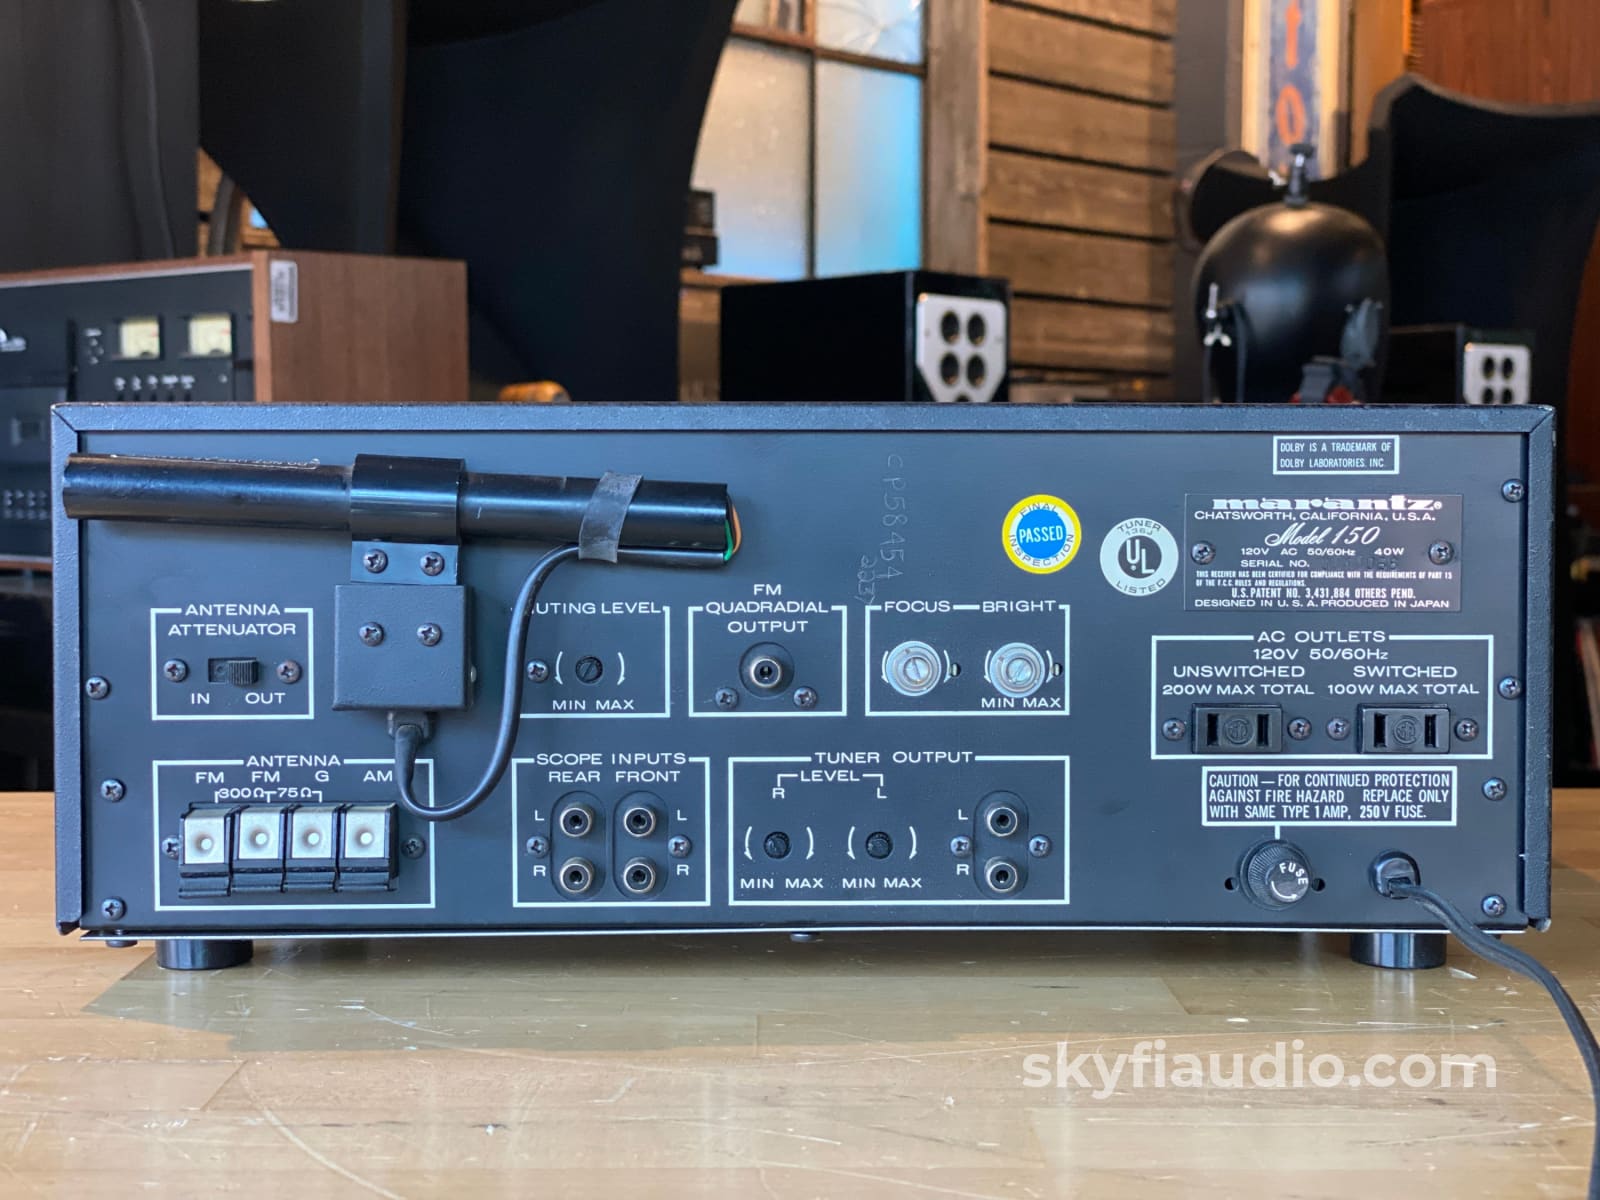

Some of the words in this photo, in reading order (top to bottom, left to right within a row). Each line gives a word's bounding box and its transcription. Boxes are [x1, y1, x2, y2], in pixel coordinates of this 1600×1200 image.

[1280, 442, 1305, 452] DOLBY
[1310, 442, 1318, 452] IS
[1321, 442, 1328, 452] A
[1331, 442, 1377, 452] TRADEMARK
[1381, 442, 1393, 452] OF
[1280, 458, 1305, 468] DOLBY
[1018, 502, 1060, 517] FINAL
[1194, 510, 1297, 521] CHATSWORTH,
[1299, 511, 1389, 521] CALIFORNIA,
[1117, 519, 1162, 533] TUNER
[1018, 524, 1064, 545] PASSED
[1264, 522, 1329, 546] Model
[1331, 525, 1381, 545] 150
[1008, 533, 1076, 567] INSPECTION
[1241, 547, 1270, 556] 120V
[1280, 547, 1298, 556] AC
[1307, 547, 1356, 556] 50/60Hz
[1374, 547, 1405, 556] 40W
[1125, 539, 1155, 574] UL
[1240, 559, 1284, 568] SERIAL
[1289, 559, 1310, 568] NO.
[1297, 570, 1308, 578] FOR
[1310, 571, 1345, 579] COMPLIANCE
[1363, 571, 1374, 579] THE
[1116, 577, 1166, 595] LISTED
[1205, 579, 1216, 587] THE
[1234, 579, 1252, 587] RULES
[1254, 579, 1266, 587] AND
[753, 584, 782, 596] FM
[1250, 588, 1282, 598] PATENT
[1286, 588, 1301, 598] NO.
[1354, 588, 1388, 599] OTHERS
[1390, 588, 1417, 599] PEND.
[185, 603, 281, 617] ANTENNA
[600, 602, 662, 615] LEVEL
[705, 601, 829, 615] QUADRADIAL
[884, 600, 951, 613] FOCUS
[982, 600, 1057, 614] BRIGHT
[1194, 599, 1257, 608] DESIGNED
[1260, 599, 1273, 608] IN
[1320, 599, 1389, 608] PRODUCED
[1394, 600, 1407, 609] IN
[1409, 600, 1450, 609] JAPAN
[168, 623, 297, 637] ATTENUATOR
[727, 621, 809, 634] OUTPUT
[1256, 630, 1286, 643] AC
[1294, 630, 1386, 643] OUTLETS
[1253, 648, 1300, 661] 120V
[1308, 648, 1389, 661] 50/60Hz
[1172, 665, 1306, 678] UNSWITCHED
[1352, 665, 1458, 678] SWITCHED
[1161, 684, 1212, 696] 200W
[1215, 684, 1256, 696] MAX
[1259, 684, 1315, 696] TOTAL
[1327, 684, 1375, 696] 100W
[1378, 684, 1420, 696] MAX
[1421, 684, 1480, 696] TOTAL
[190, 693, 211, 705] IN
[244, 692, 287, 705] OUT
[981, 697, 1015, 709] MIN
[1022, 697, 1062, 709] MAX
[552, 699, 586, 711] MIN
[595, 699, 635, 711] MAX
[246, 755, 341, 768] ANTENNA
[536, 753, 603, 766] SCOPE
[610, 752, 687, 766] INPUTS
[814, 751, 880, 764] TUNER
[892, 750, 973, 764] OUTPUT
[195, 771, 225, 784] FM
[251, 771, 281, 783] FM
[314, 770, 330, 783] G
[362, 770, 394, 782] AM
[548, 770, 601, 783] REAR
[614, 770, 681, 783] FRONT
[800, 770, 861, 782] LEVEL
[1277, 773, 1300, 787] FOR
[1304, 773, 1371, 787] CONTINUED
[1374, 773, 1451, 787] PROTECTION
[772, 788, 785, 799] R
[876, 788, 887, 799] L
[1208, 790, 1261, 802] AGAINST
[1265, 790, 1292, 802] FIRE
[1296, 790, 1345, 803] HAZARD
[1362, 789, 1413, 802] REPLACE
[1418, 789, 1450, 802] ONLY
[534, 810, 545, 821] L
[676, 810, 687, 821] L
[957, 809, 968, 820] L
[1209, 805, 1239, 818] WITH
[1244, 805, 1276, 818] SAME
[1282, 805, 1310, 818] TYPE
[1394, 804, 1428, 818] FUSE.
[533, 865, 546, 876] R
[676, 864, 689, 876] R
[956, 864, 969, 875] R
[1278, 862, 1309, 885] FUSE
[740, 878, 774, 889] MIN
[785, 878, 824, 889] MAX
[842, 877, 876, 889] MIN
[883, 877, 922, 889] MAX
